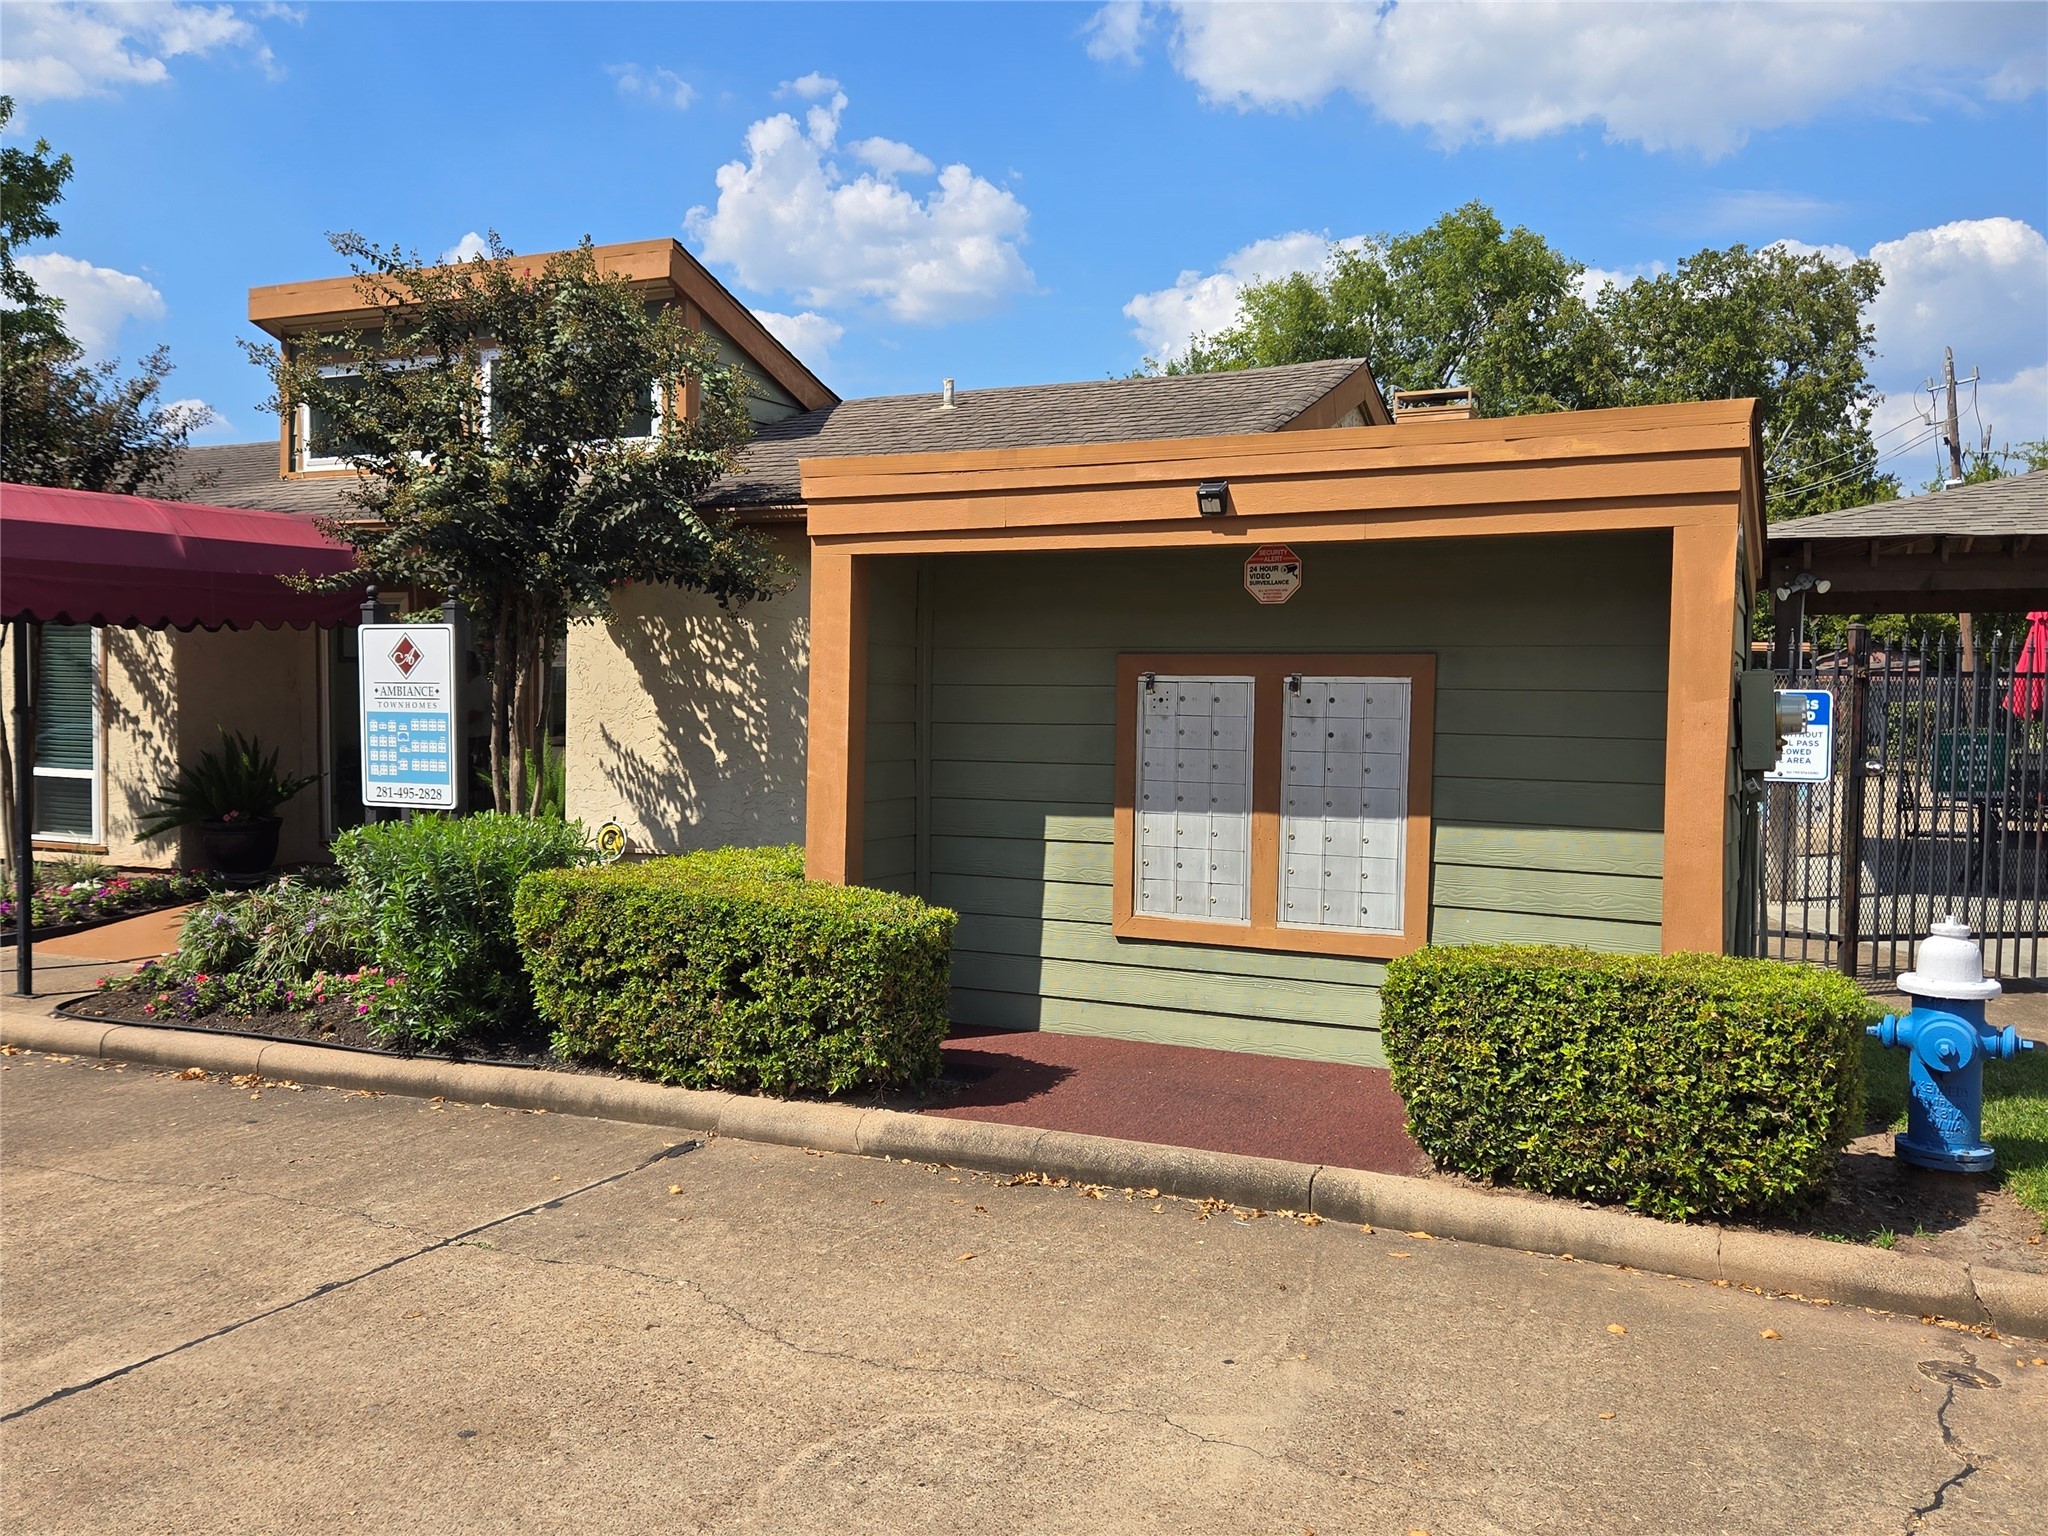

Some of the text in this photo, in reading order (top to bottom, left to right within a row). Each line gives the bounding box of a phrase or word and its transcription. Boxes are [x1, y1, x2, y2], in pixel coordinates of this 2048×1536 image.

[380, 685, 434, 697] AMBIANCE
[378, 701, 437, 709] TOWNHOMES
[376, 786, 442, 800] 281-495-2828
